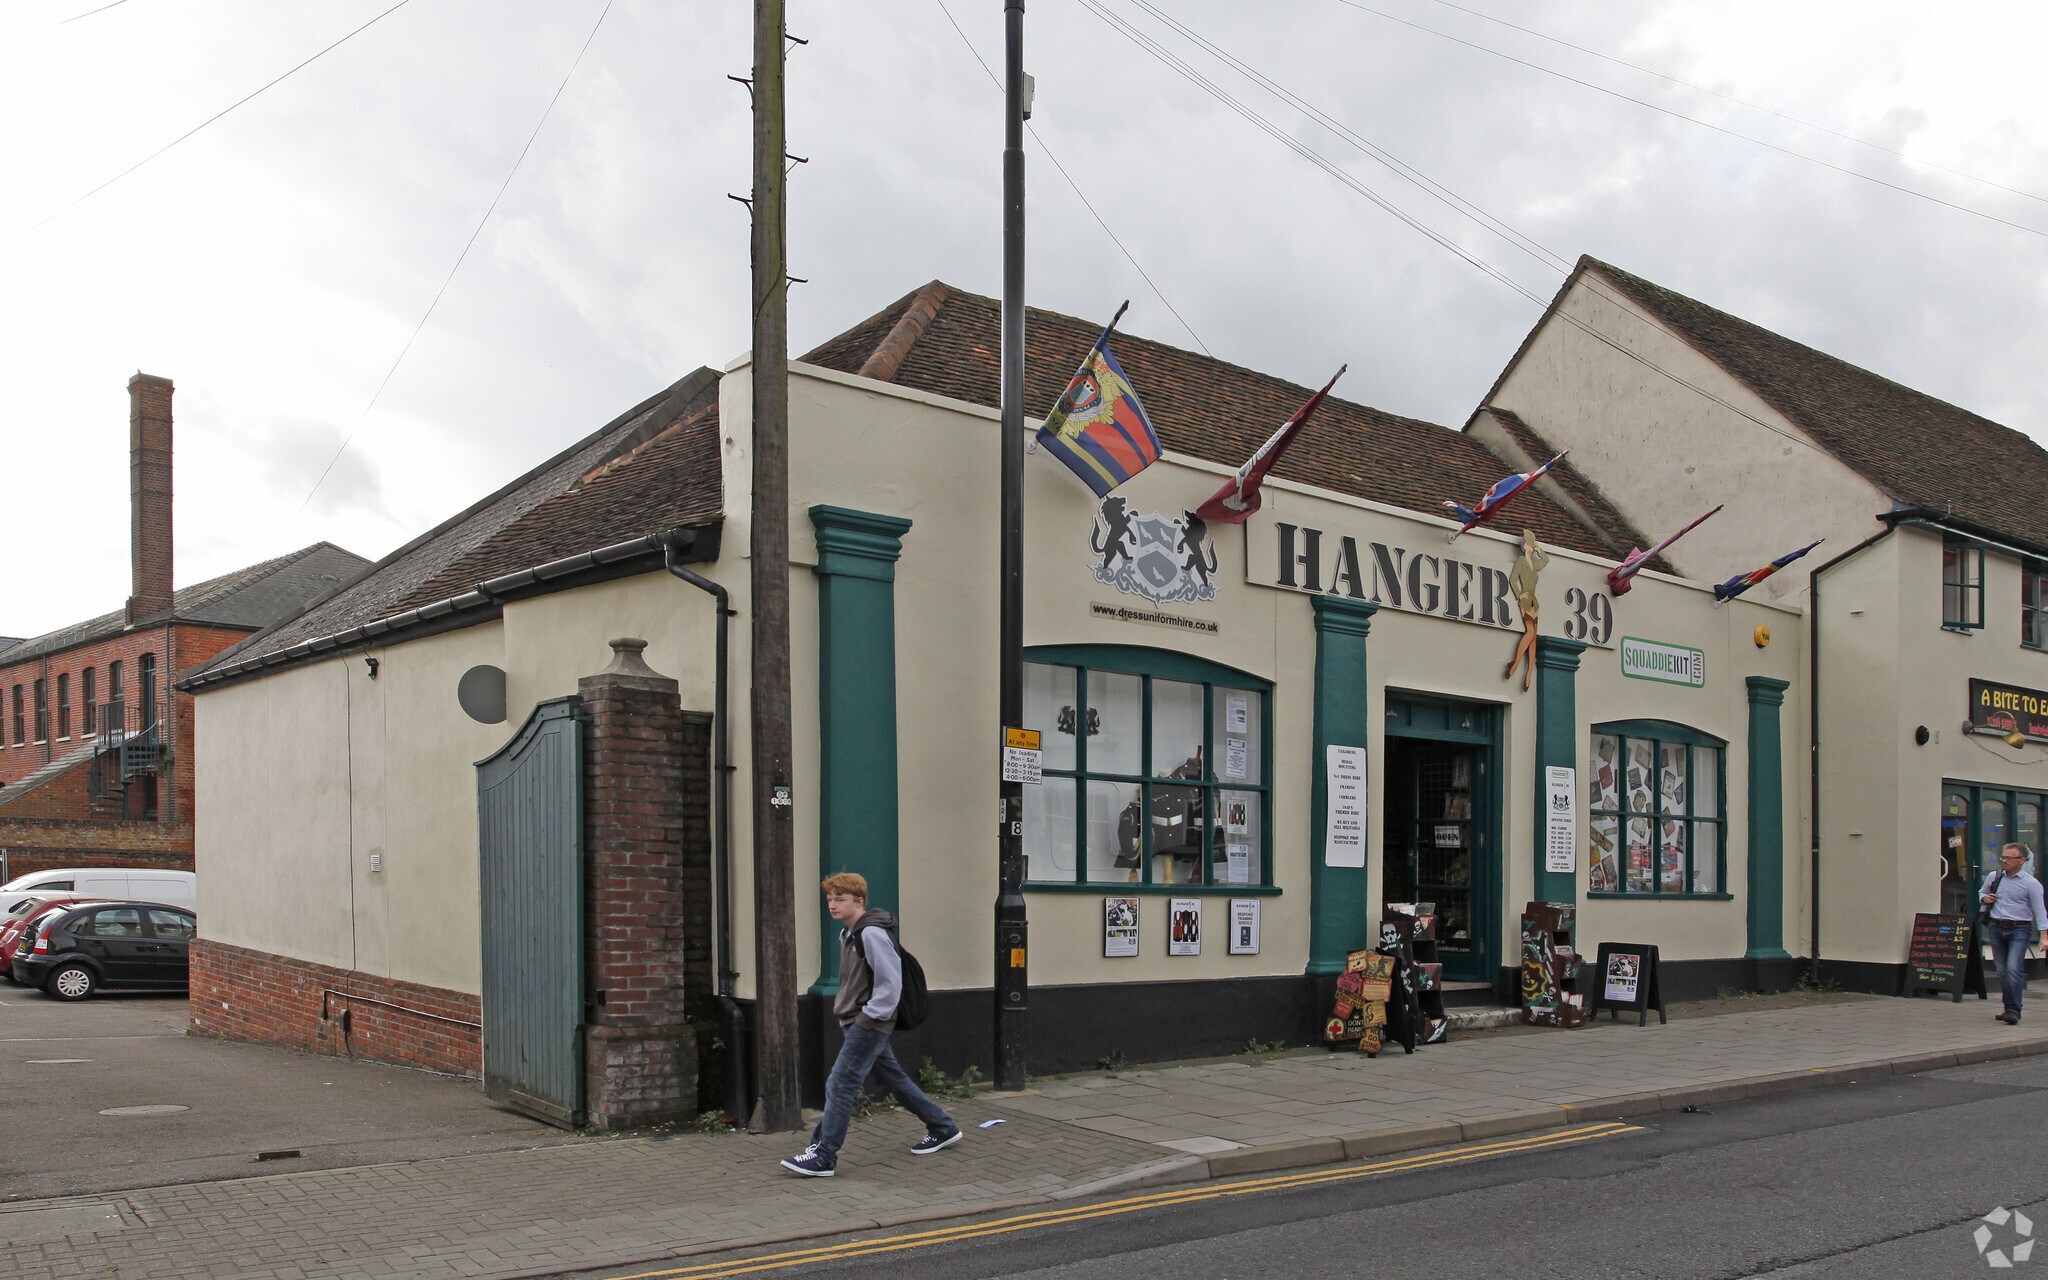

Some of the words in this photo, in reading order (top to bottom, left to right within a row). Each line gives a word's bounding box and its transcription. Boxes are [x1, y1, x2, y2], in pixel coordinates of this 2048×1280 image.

[1275, 521, 1513, 628] HANGER
[1564, 587, 1613, 646] 39
[1093, 604, 1219, 633] www.dressuniformhire.co.uk
[1981, 688, 1991, 706] A
[1993, 690, 2020, 711] BITE
[2022, 695, 2038, 714] TO
[2040, 699, 2048, 717] E
[1027, 740, 1038, 748] time
[1019, 749, 1037, 758] loading
[1013, 822, 1022, 835] 8
[1435, 833, 1459, 841] OPEN
[1367, 1034, 1378, 1042] GO
[1361, 1040, 1379, 1050] ZONE
